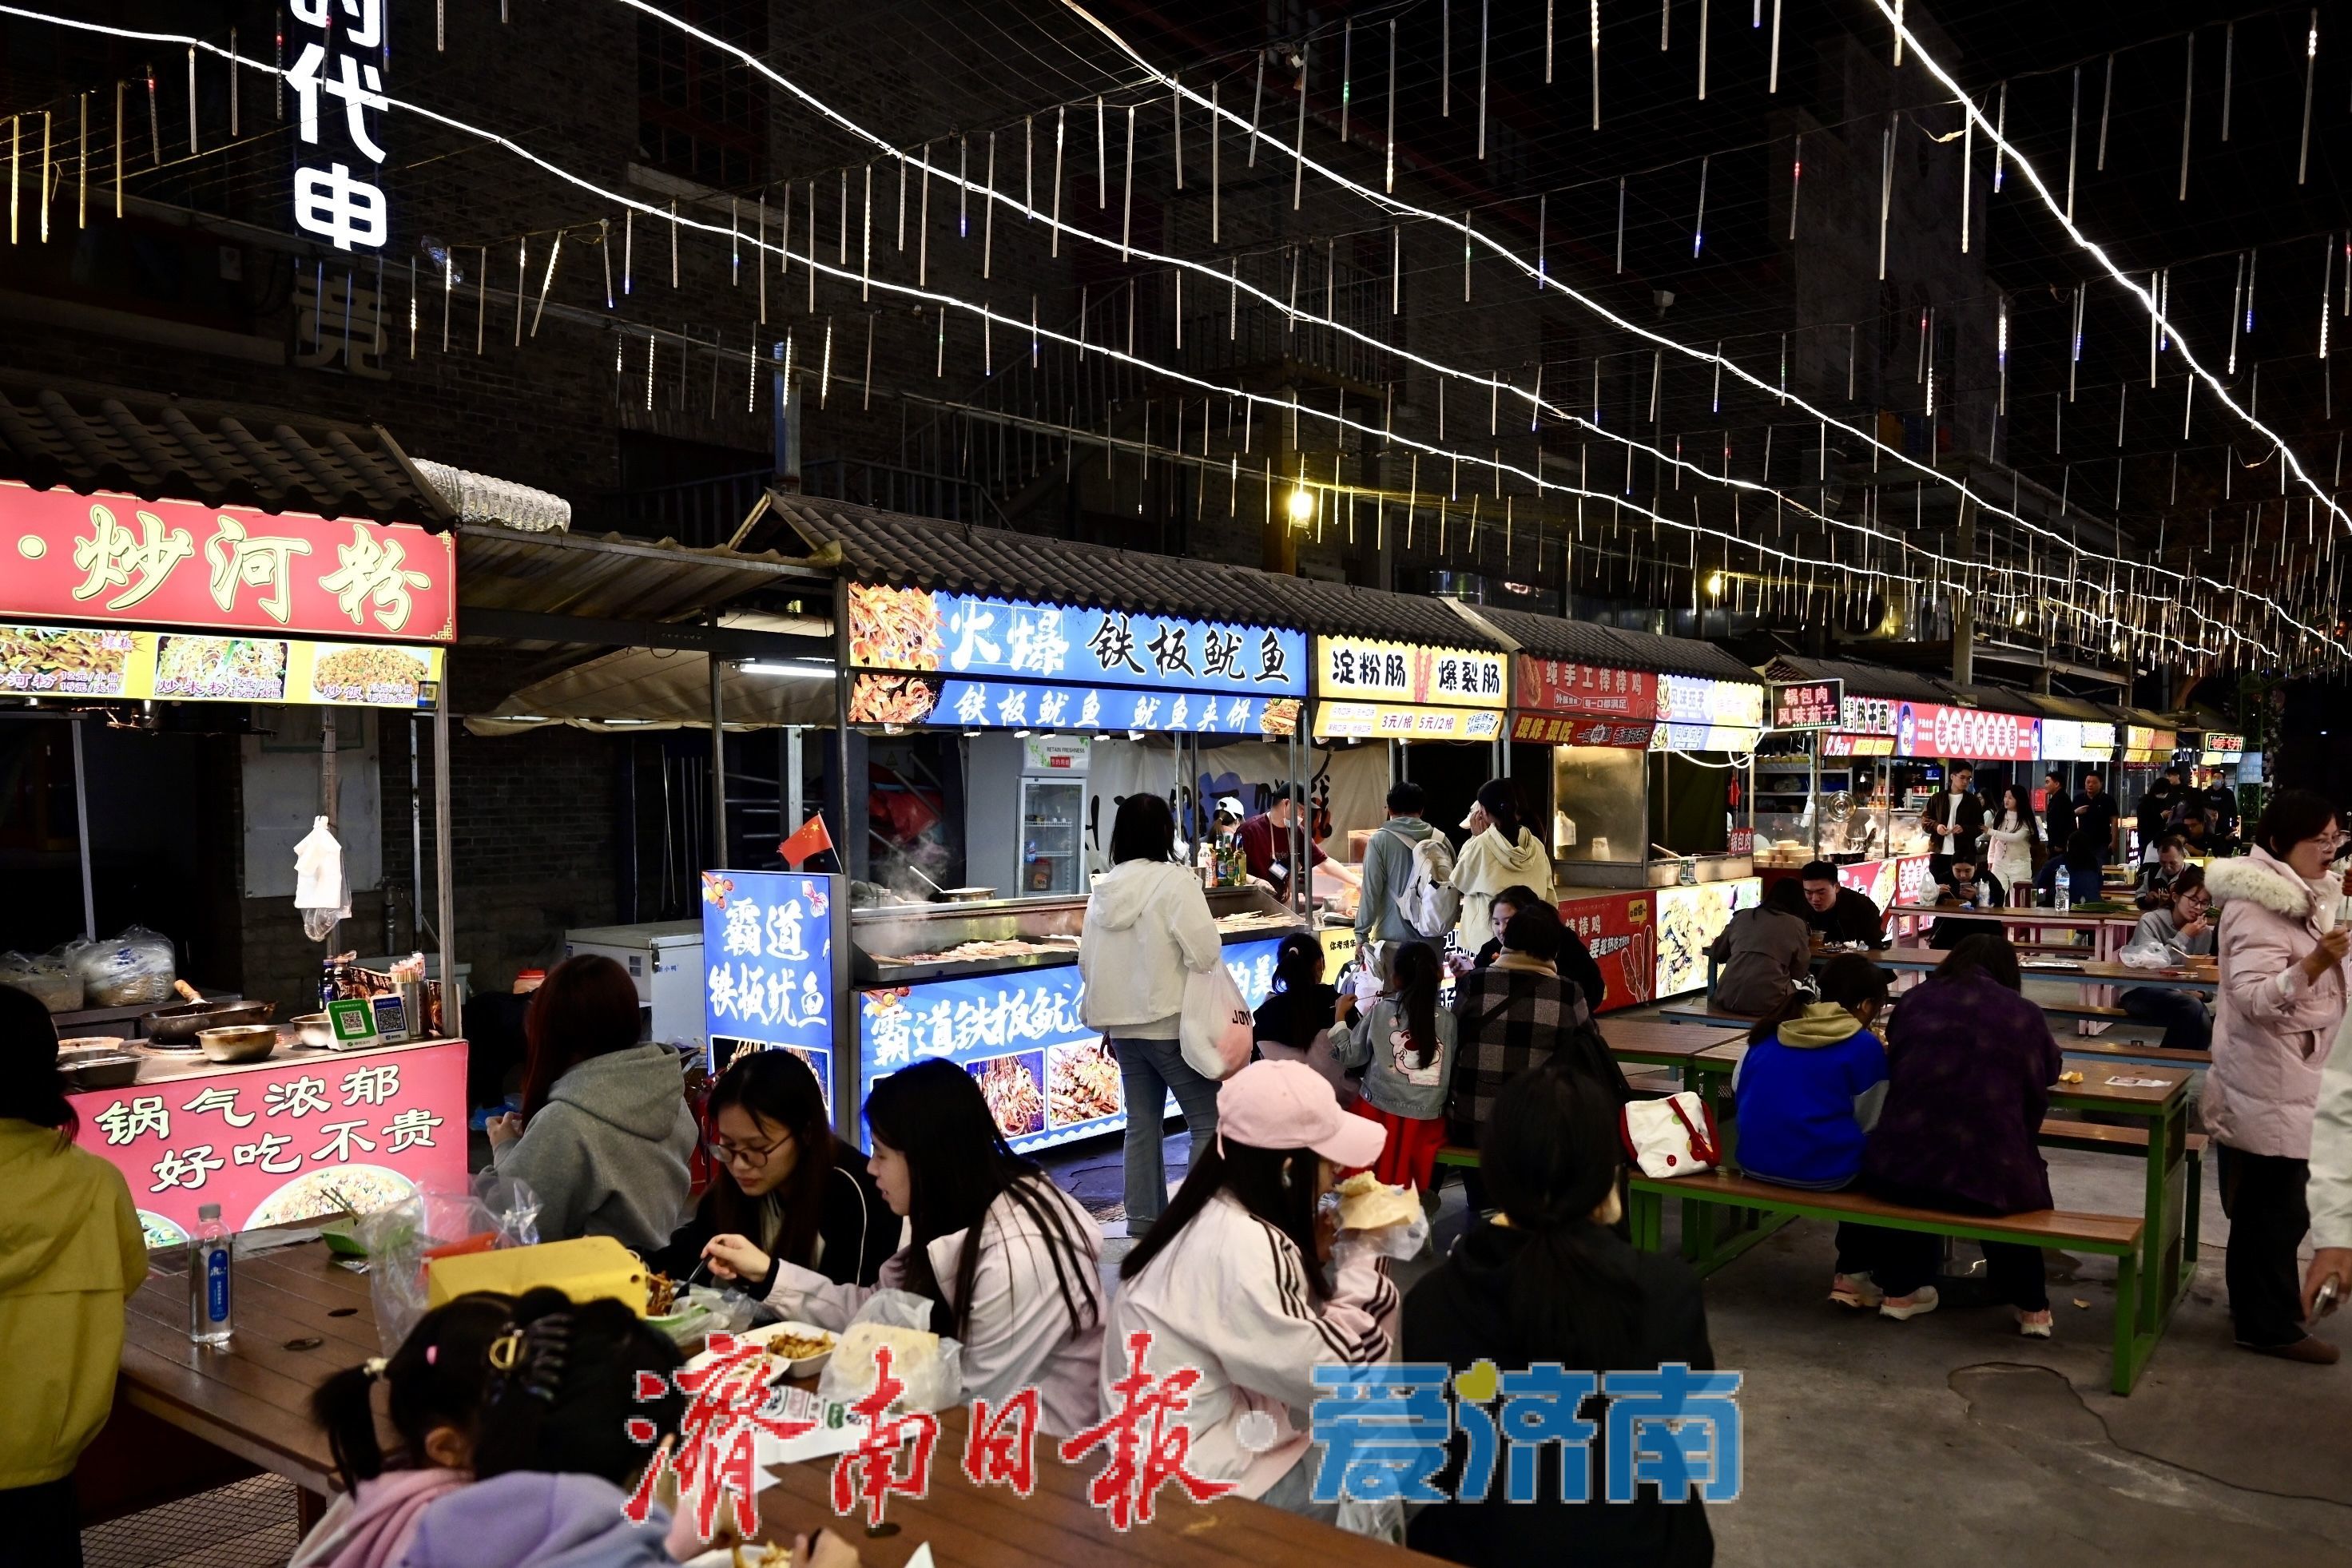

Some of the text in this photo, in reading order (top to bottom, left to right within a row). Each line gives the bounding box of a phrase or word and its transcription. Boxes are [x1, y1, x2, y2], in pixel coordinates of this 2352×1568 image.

[950, 599, 1290, 685] 火爆 铁板鱿鱼
[0, 673, 58, 690] 河粉
[61, 671, 119, 683] 12元/小份
[1332, 649, 1500, 695] 淀粉肠 爆裂肠
[1546, 660, 1643, 696] 纯手工棒棒鸡
[61, 681, 119, 693] 15元/大份
[157, 679, 228, 696] 炒米粉
[324, 685, 364, 701] 炒饭
[1783, 685, 1829, 706] 锅包肉
[954, 683, 1252, 734] 铁板鱿鱼 鱿鱼夹饼
[1777, 704, 1838, 725] 风味茄子
[1857, 701, 1889, 732] 热干面
[1381, 715, 1413, 728] 3元/根
[1419, 716, 1454, 730] 5元/2根
[1515, 716, 1546, 740] 现炸
[1546, 720, 1575, 742] 现吃
[2211, 737, 2243, 749] 卷饼
[1730, 831, 1752, 851] 锅包肉
[722, 896, 809, 962] 霸道
[709, 961, 828, 1029] 铁板鱿鱼
[94, 1064, 400, 1146] 锅气浓郁
[149, 1108, 444, 1193] 好吃不贵
